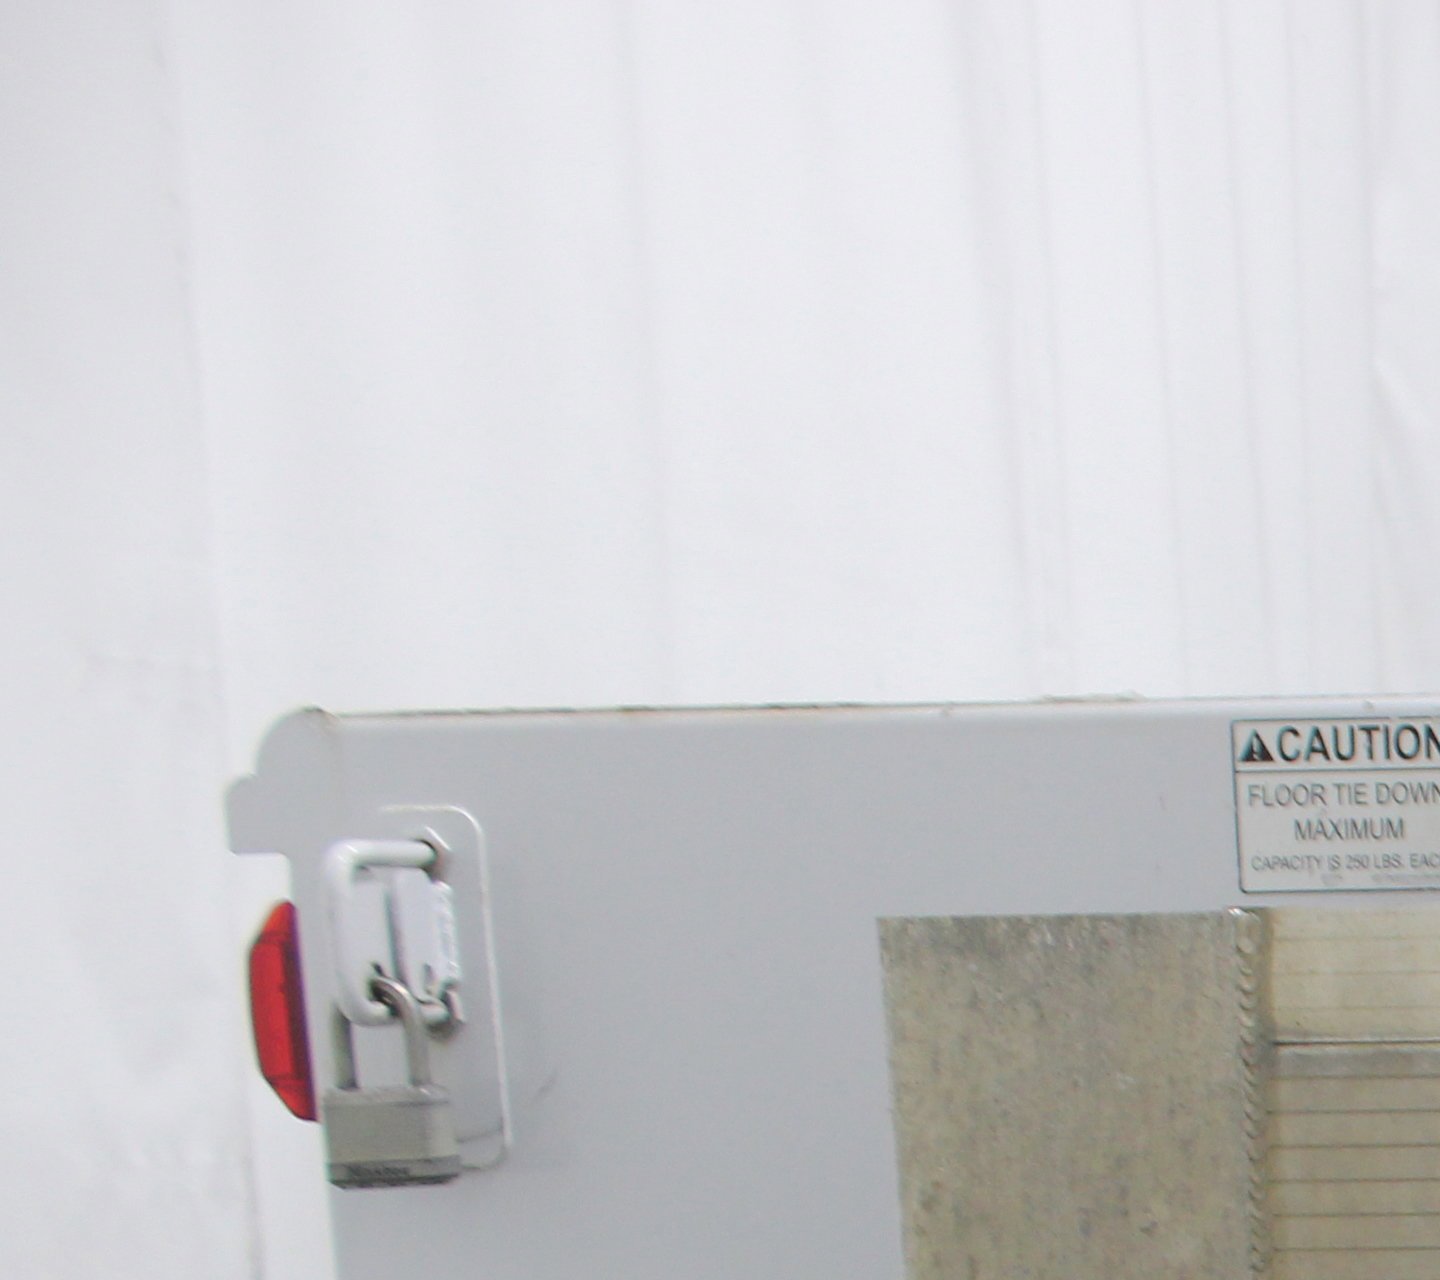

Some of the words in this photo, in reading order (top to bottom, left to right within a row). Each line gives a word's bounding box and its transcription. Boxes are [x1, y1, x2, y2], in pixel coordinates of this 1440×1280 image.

[1248, 783, 1327, 807] FLOOR
[1332, 782, 1369, 804] TIE
[1294, 817, 1405, 841] MAXIMUM
[1251, 855, 1322, 871] CAPACITY
[1327, 855, 1342, 871] IS
